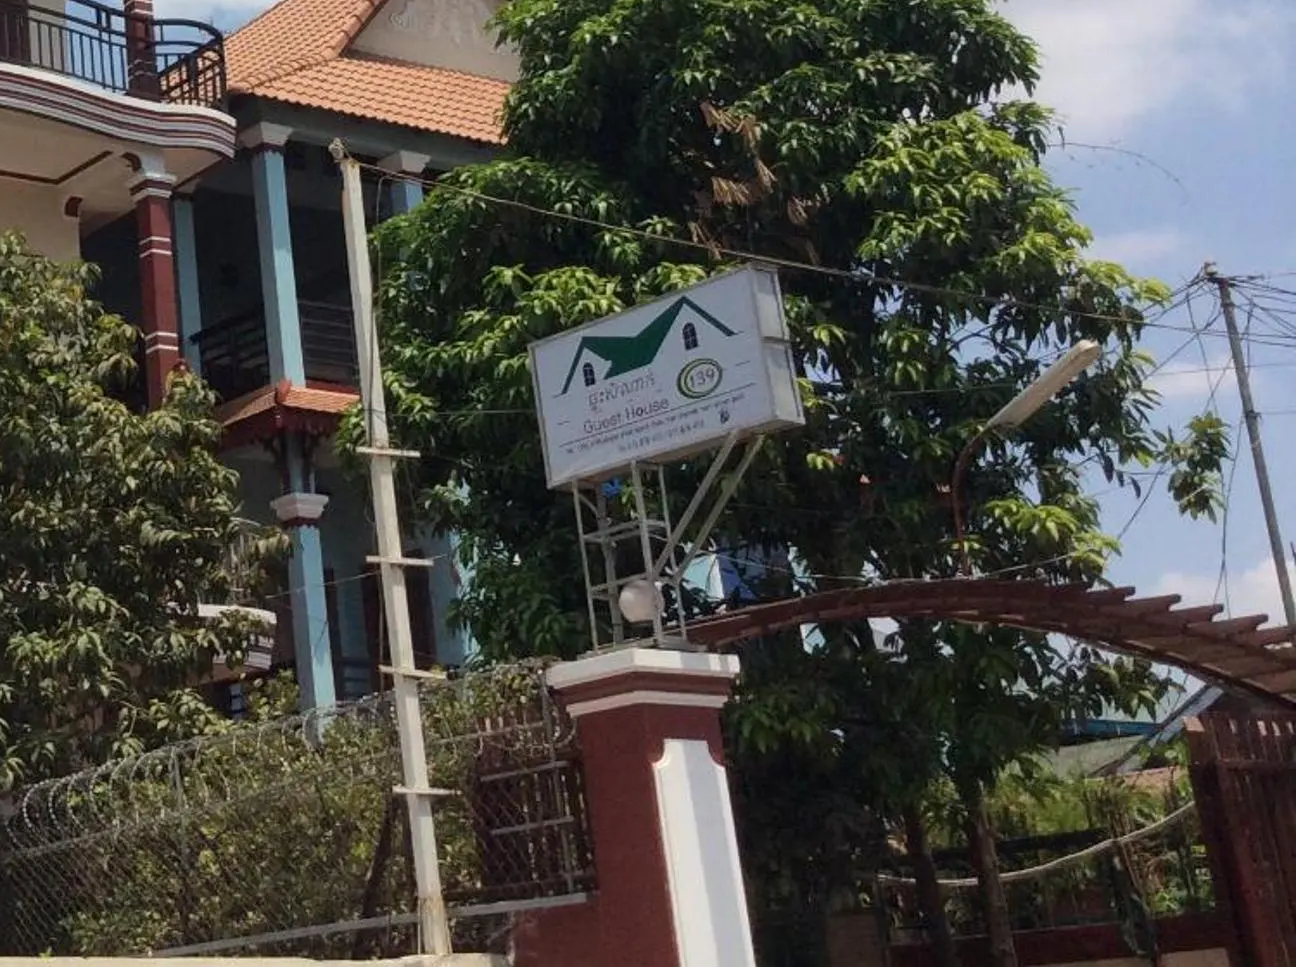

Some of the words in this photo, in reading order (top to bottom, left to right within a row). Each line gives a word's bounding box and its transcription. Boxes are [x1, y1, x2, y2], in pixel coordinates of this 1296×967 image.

[690, 368, 715, 388] 139
[583, 413, 622, 433] Guest
[624, 398, 670, 422] House
